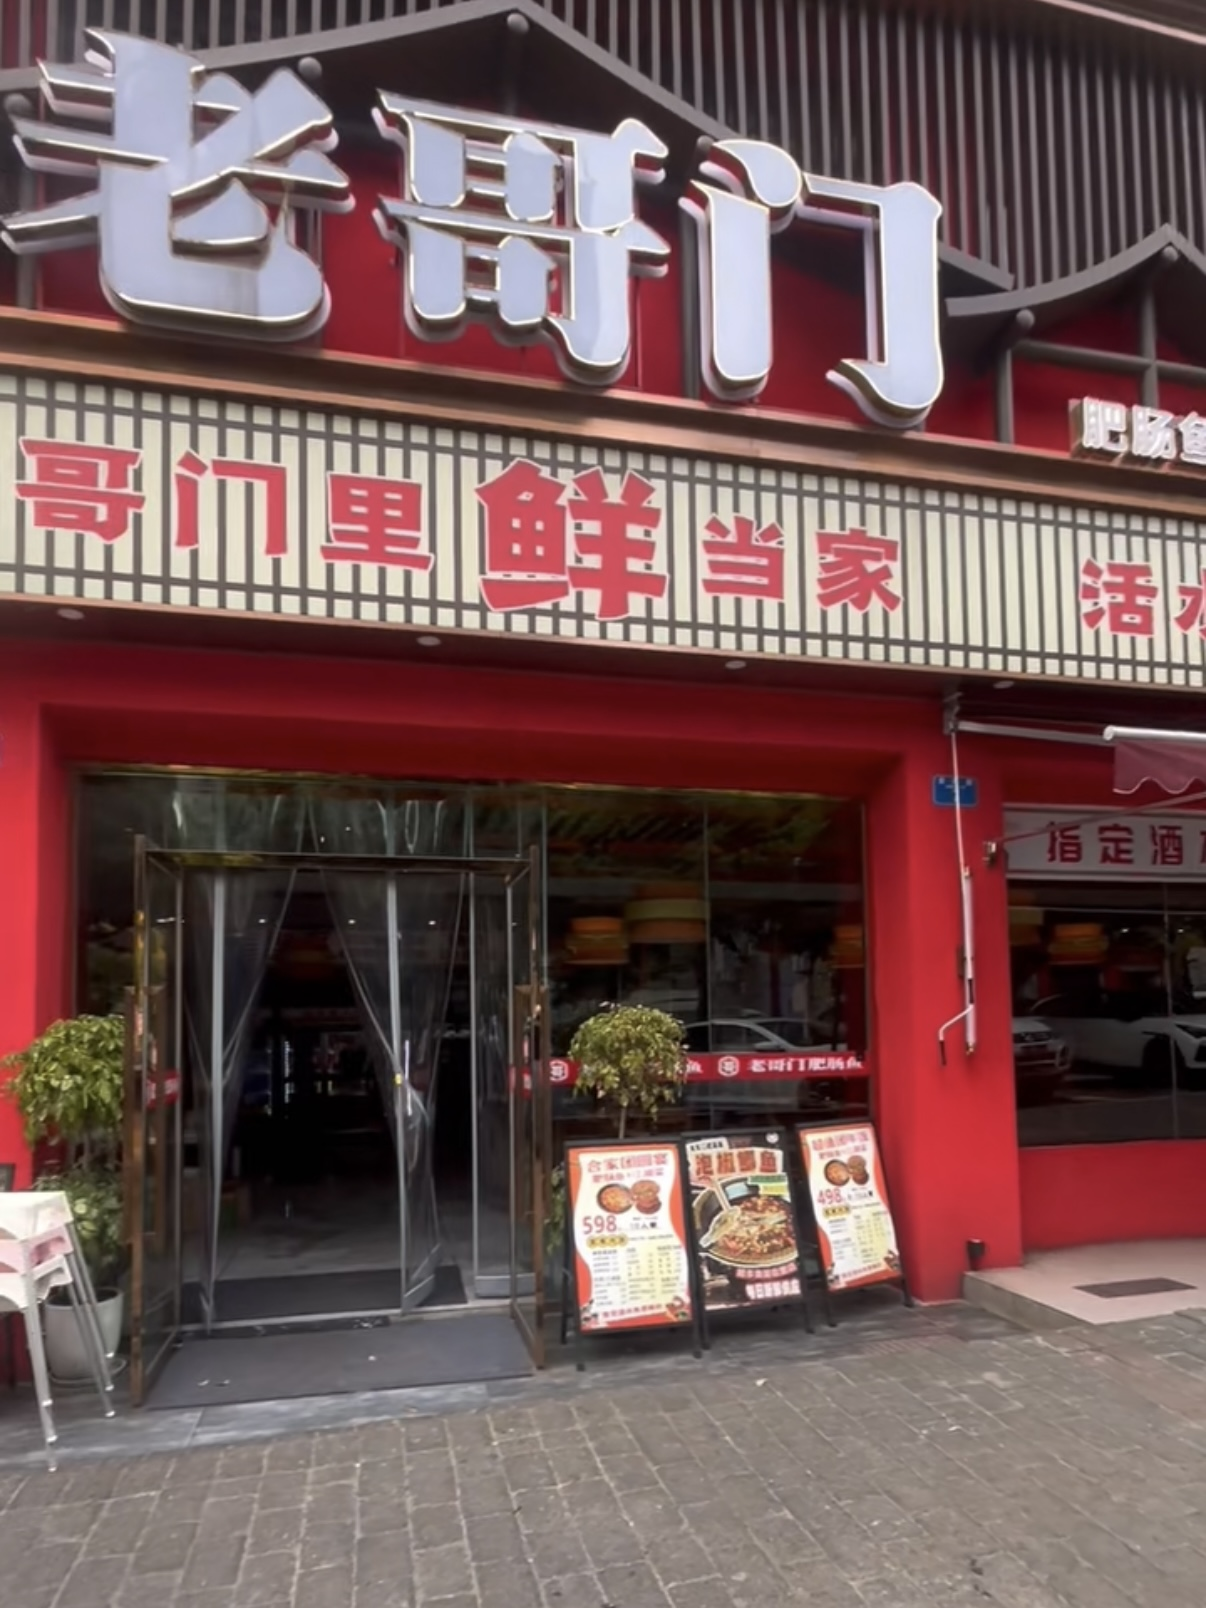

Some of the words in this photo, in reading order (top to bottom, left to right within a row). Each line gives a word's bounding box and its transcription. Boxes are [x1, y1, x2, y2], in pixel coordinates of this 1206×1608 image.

[2, 27, 943, 424] 老哥门
[1081, 396, 1206, 466] 肥肠鱼
[14, 436, 903, 622] 哥门里鲜当家
[1046, 821, 1206, 866] 指定酒
[748, 1056, 864, 1073] 老哥门肥肠鱼
[582, 1214, 618, 1236] 598
